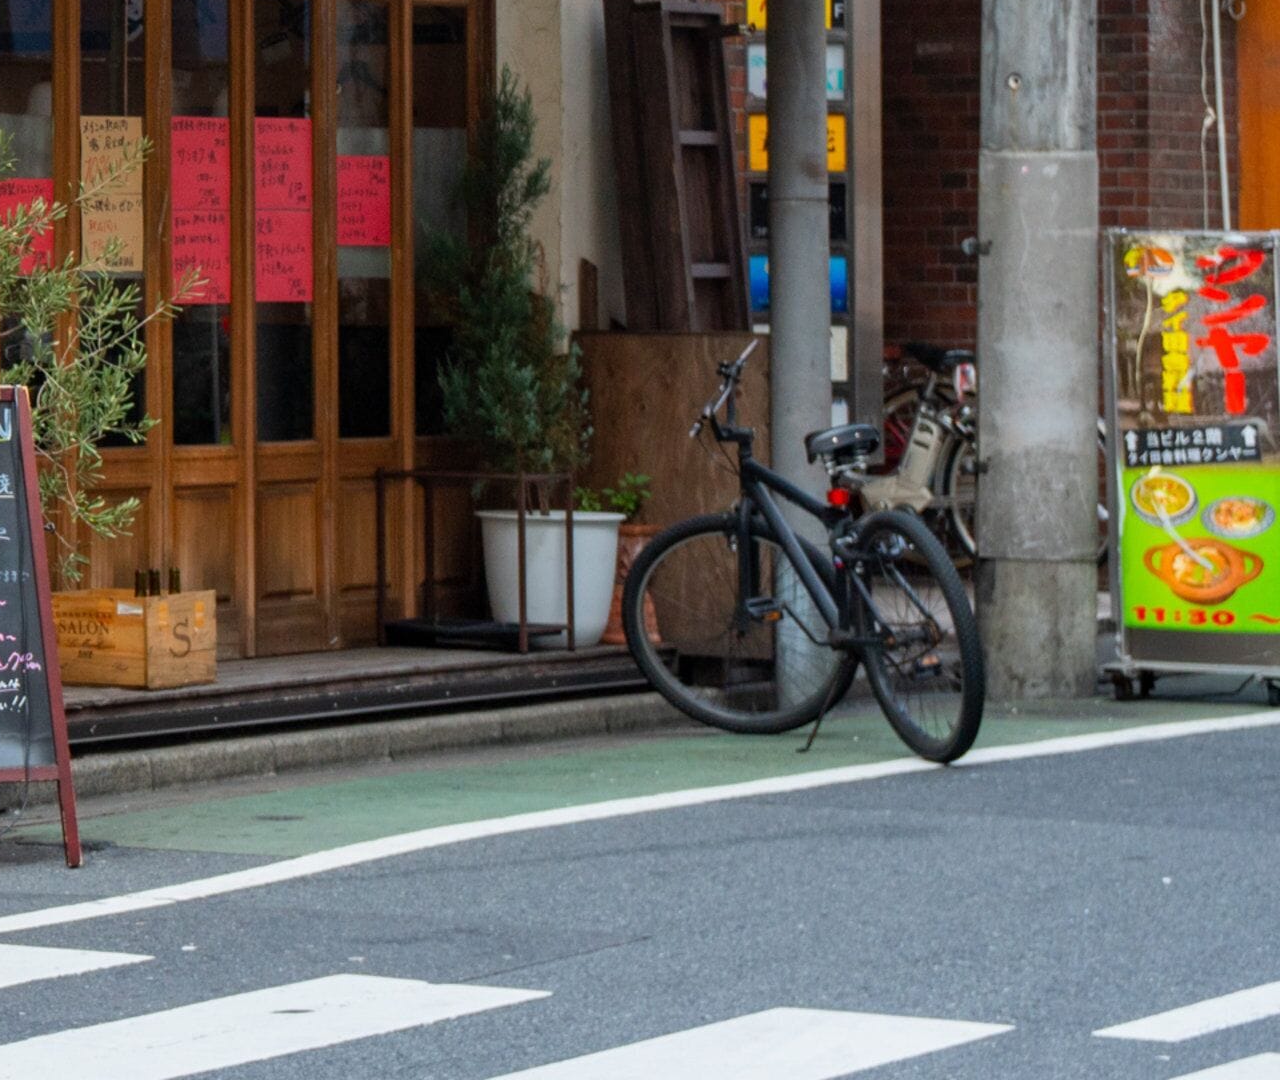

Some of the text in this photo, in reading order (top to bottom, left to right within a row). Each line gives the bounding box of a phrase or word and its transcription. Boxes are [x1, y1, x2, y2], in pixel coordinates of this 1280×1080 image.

[1195, 246, 1271, 415] クンヤー
[1146, 426, 1223, 450] 当ビル2階
[1127, 446, 1258, 466] タイ田舎料理クンヤー
[1133, 605, 1236, 625] 11:30
[57, 621, 110, 636] SALON
